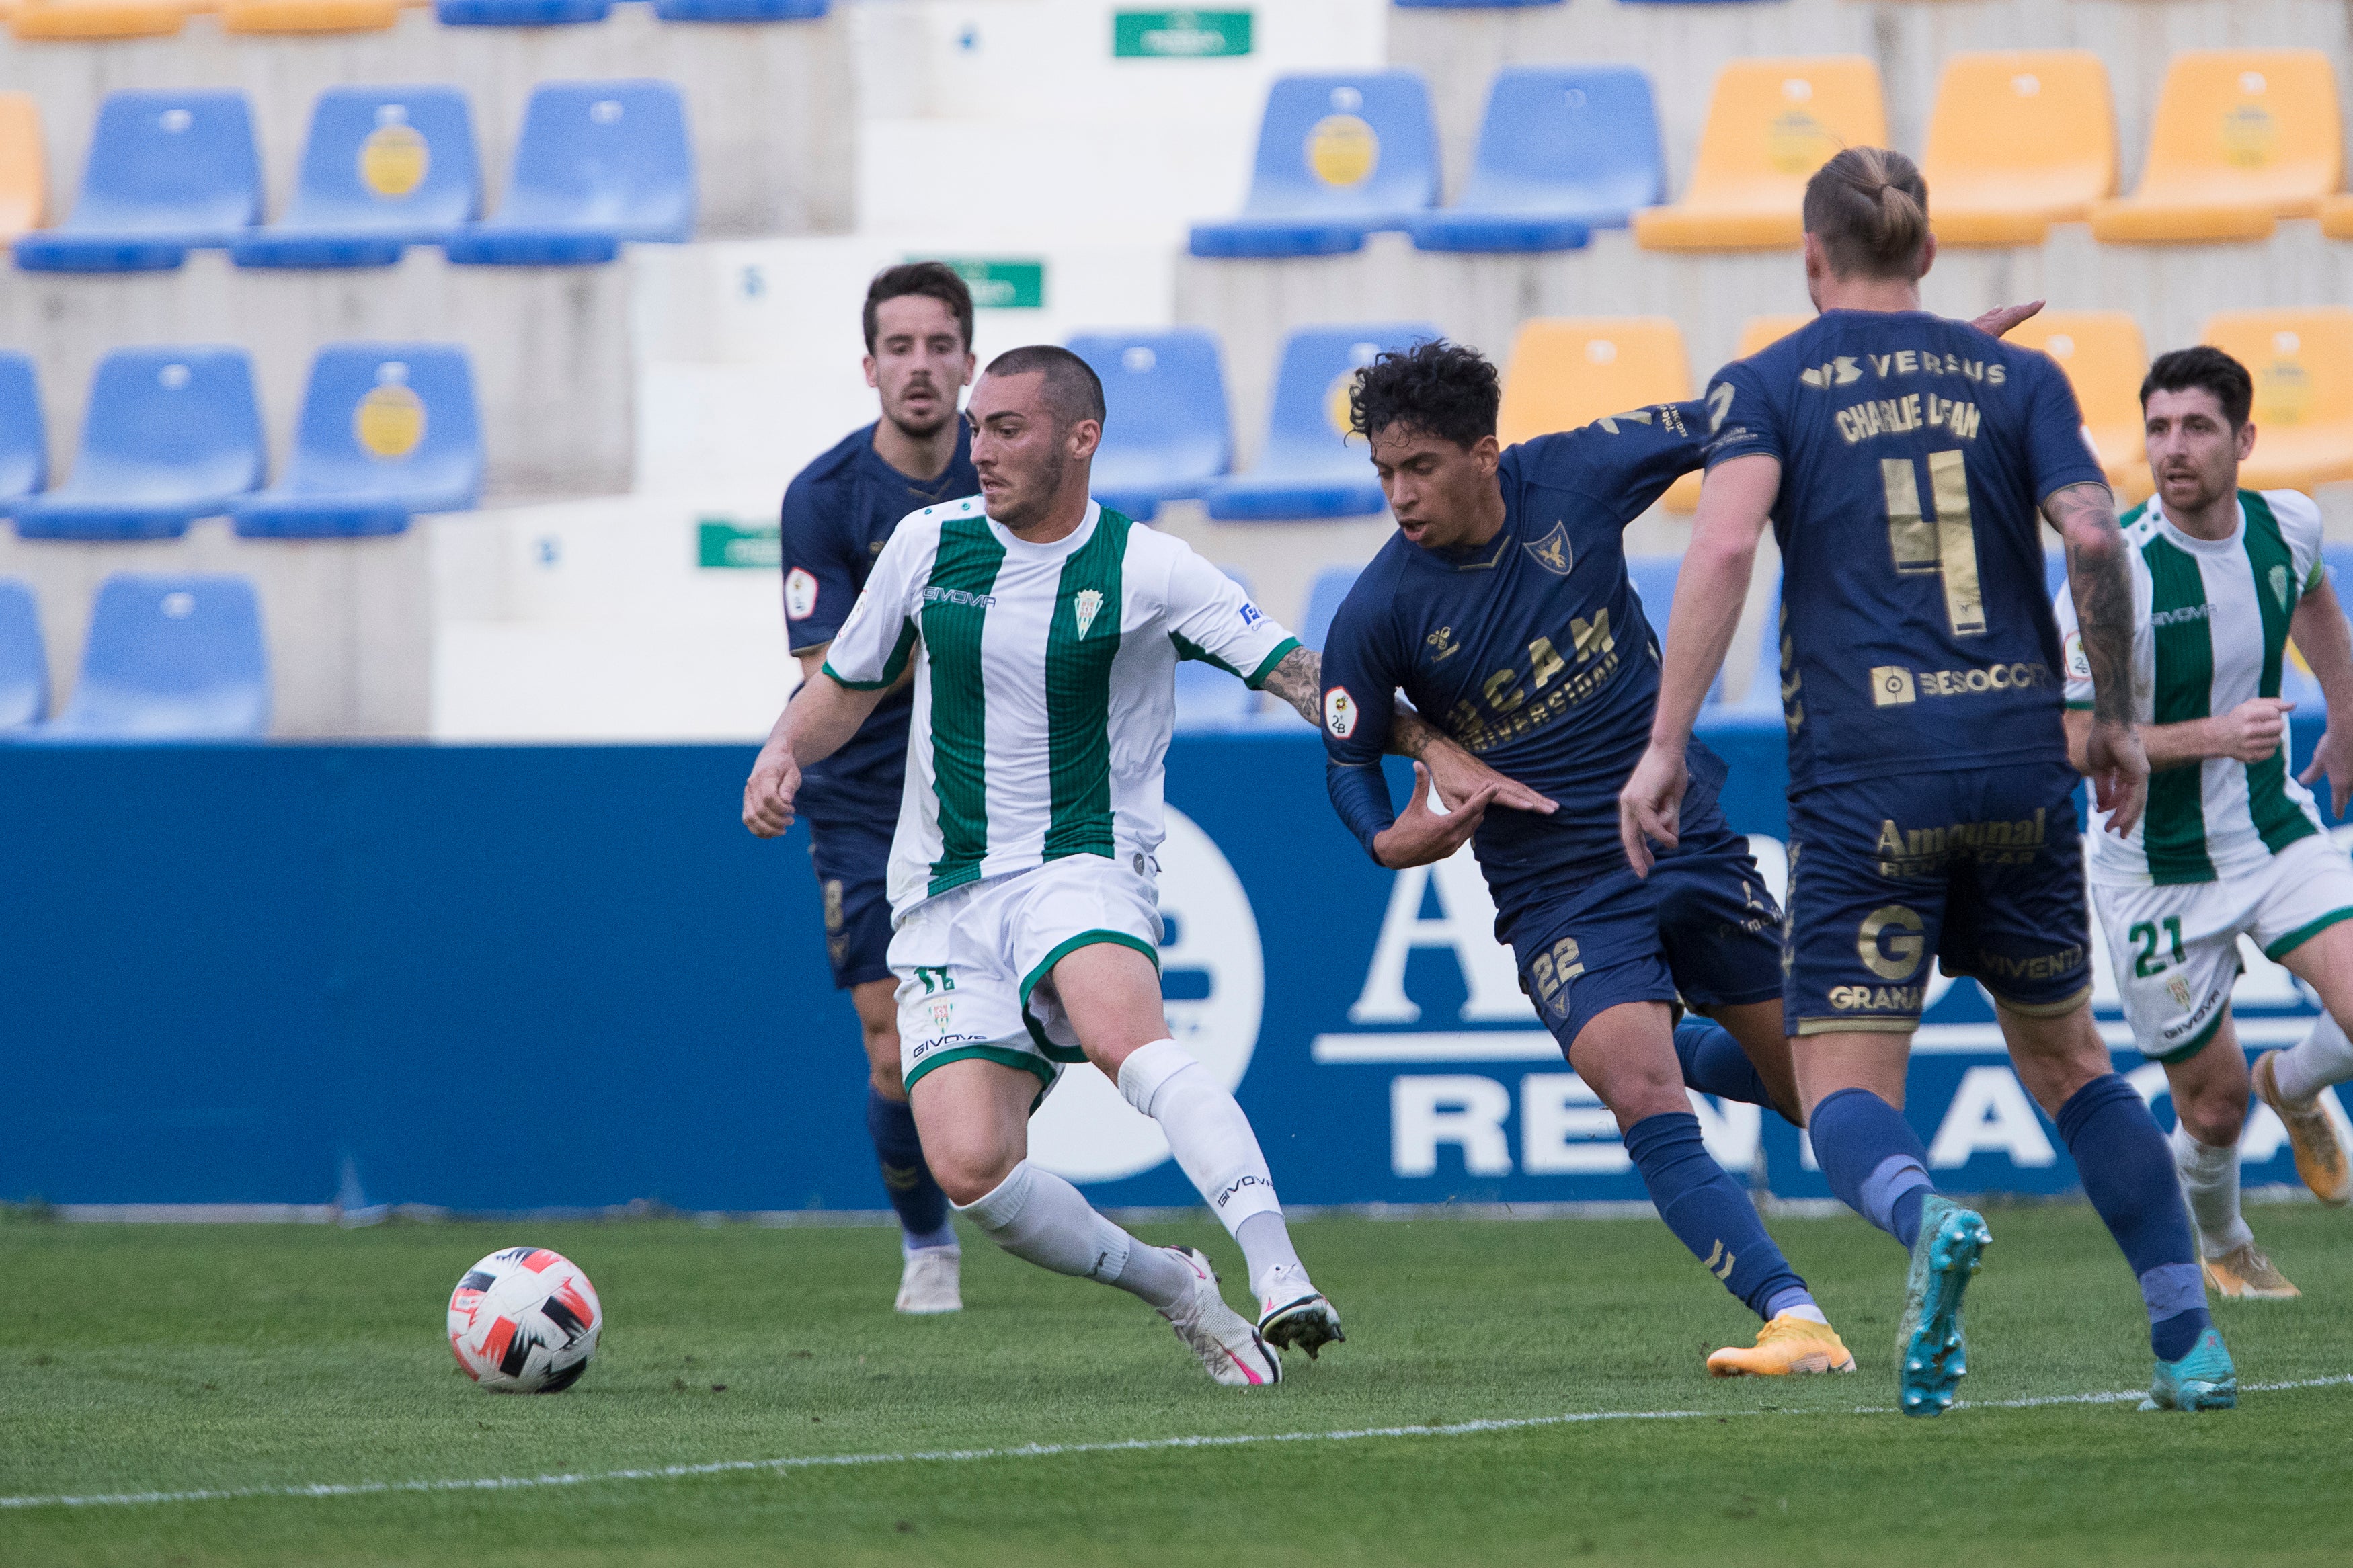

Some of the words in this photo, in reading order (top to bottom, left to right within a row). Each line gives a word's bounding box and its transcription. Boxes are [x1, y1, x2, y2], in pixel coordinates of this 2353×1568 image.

[1835, 393, 1923, 442] CHARLIE
[1881, 449, 1987, 636] 4
[922, 586, 996, 608] GIVOVA
[1533, 937, 1585, 1002] 22
[1858, 905, 1924, 979] G
[2129, 915, 2186, 979] 21
[2164, 989, 2220, 1039] GIVOVA
[1390, 1073, 1823, 1178] REN
